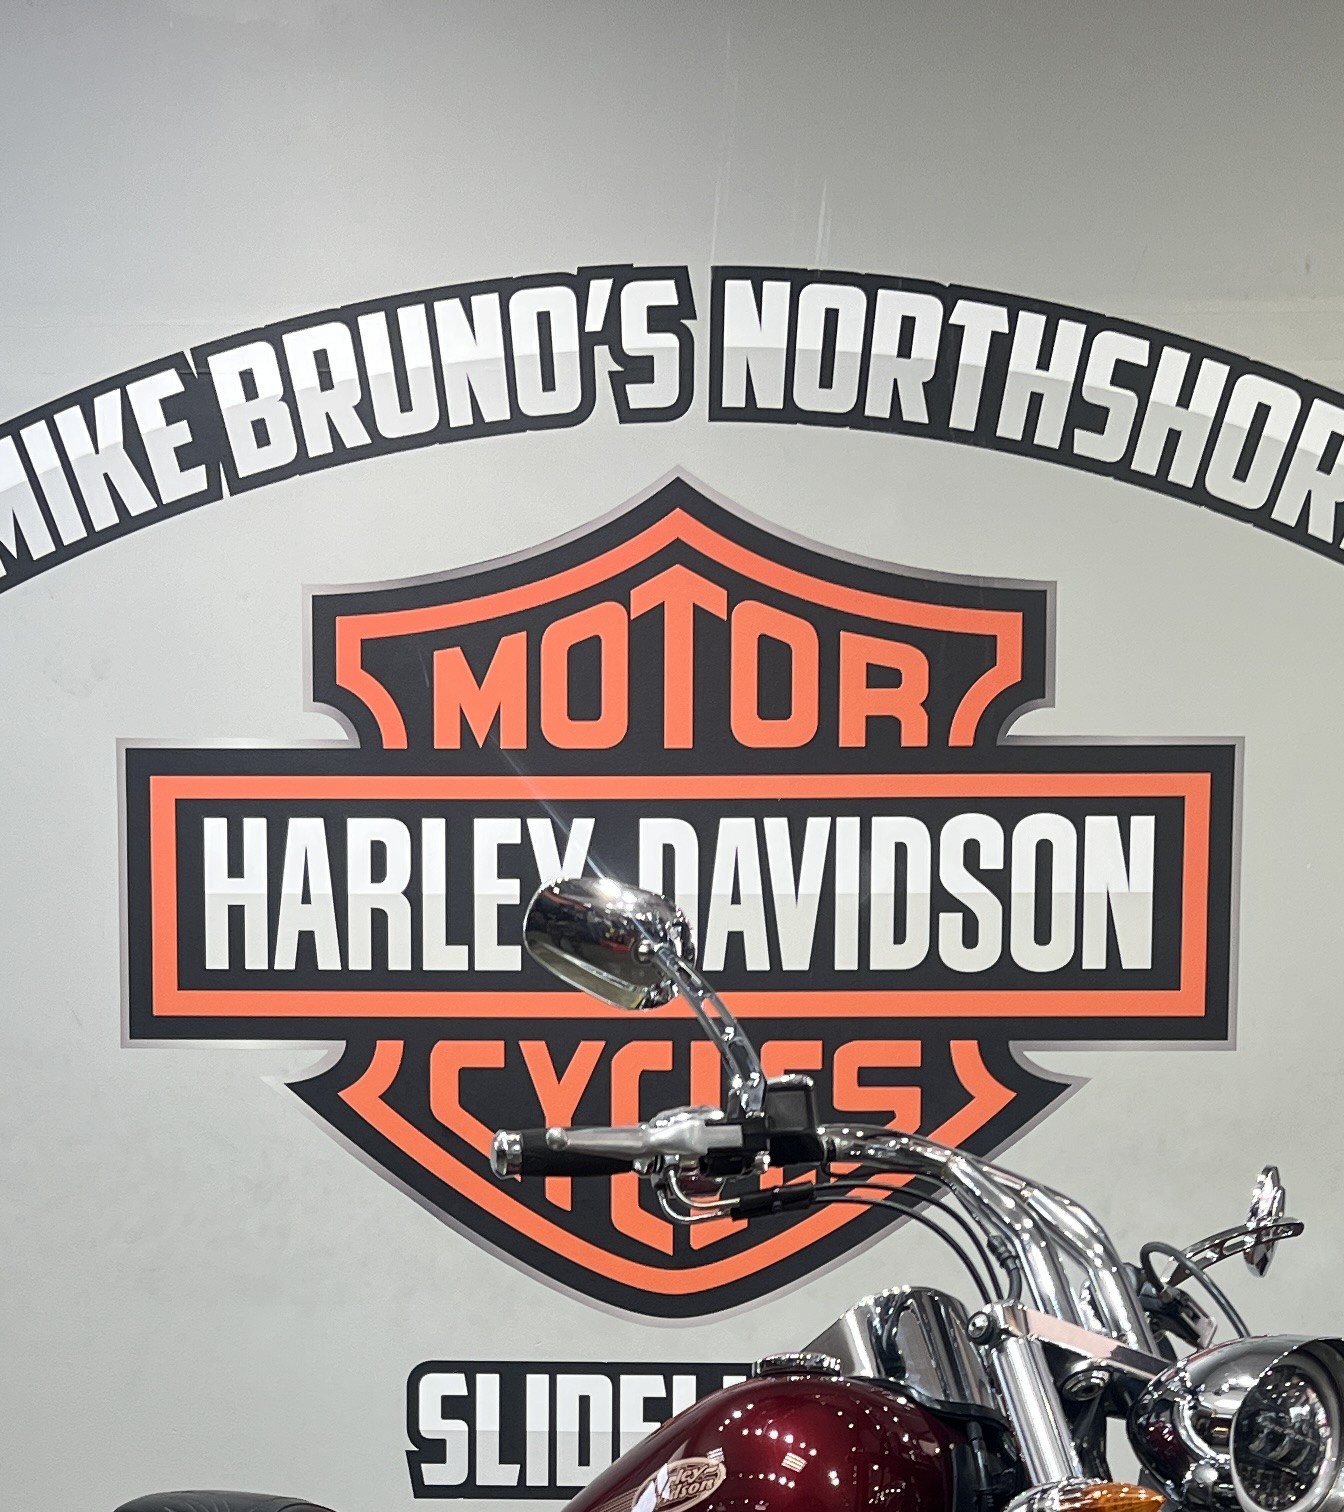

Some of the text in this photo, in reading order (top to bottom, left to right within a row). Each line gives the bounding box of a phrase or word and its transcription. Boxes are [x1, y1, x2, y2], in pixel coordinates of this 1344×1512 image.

[207, 278, 681, 480] BRUNO'S
[433, 565, 930, 750] MOTOR
[417, 1371, 748, 1488] SLIDE
